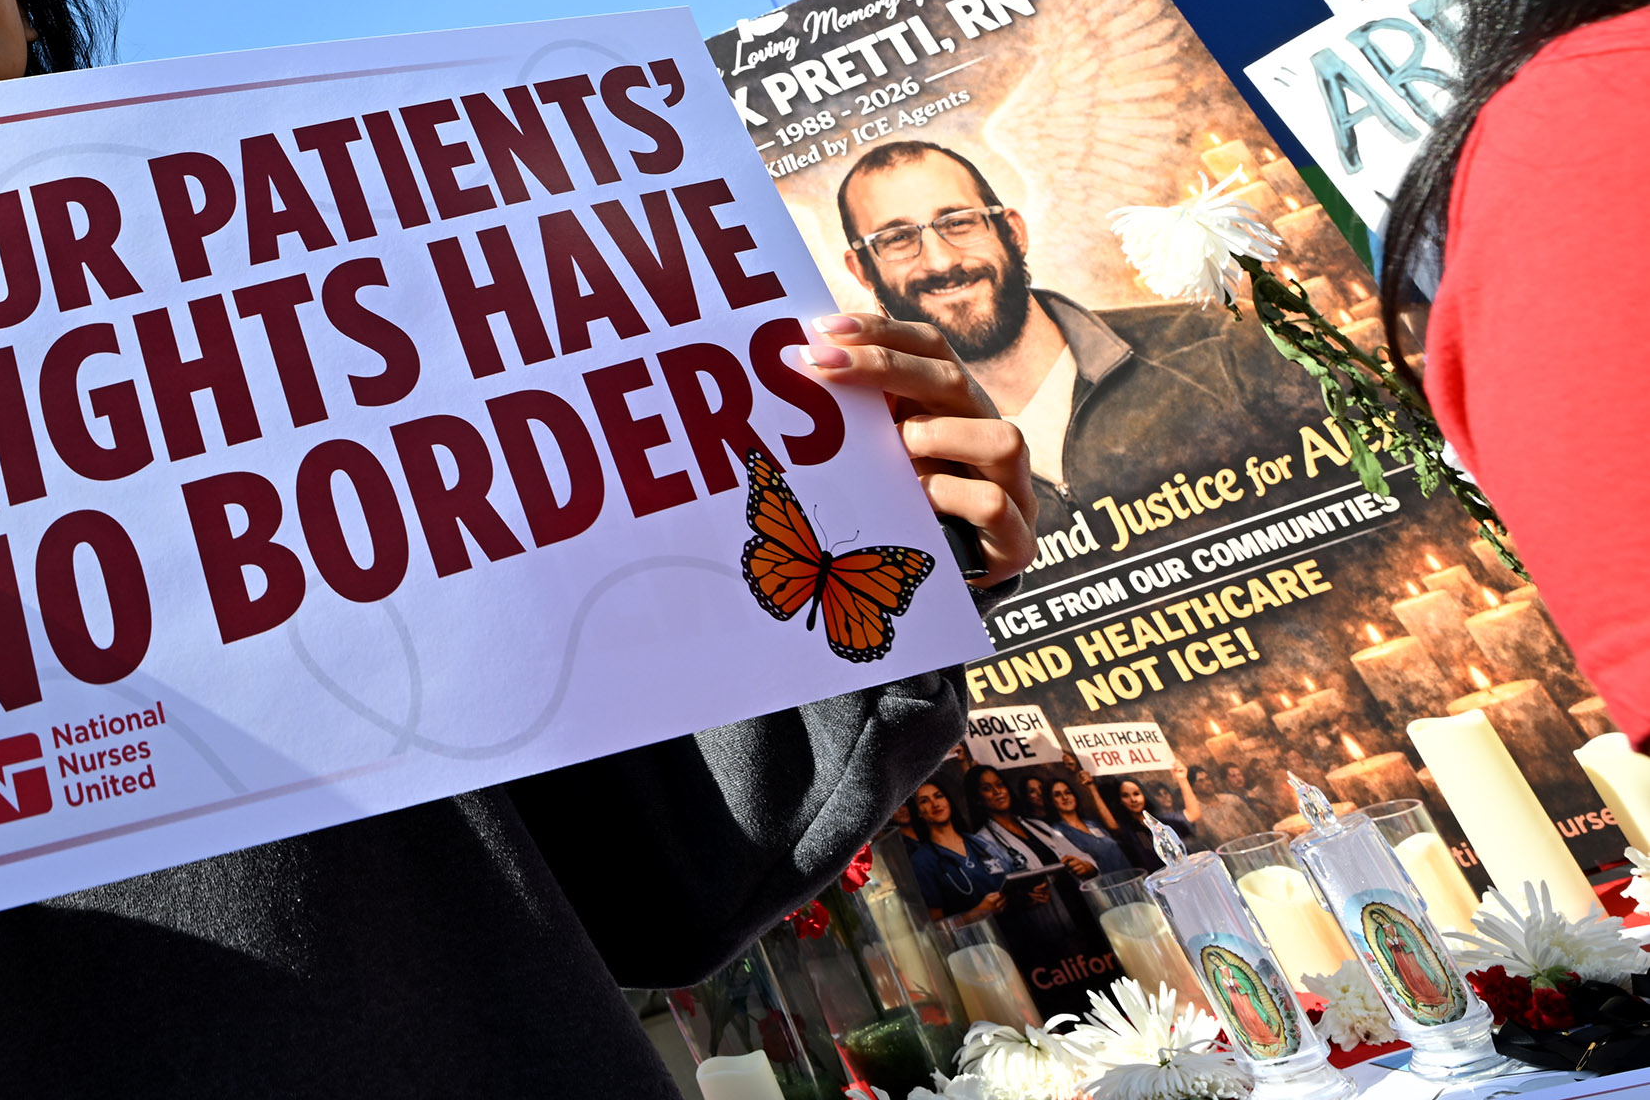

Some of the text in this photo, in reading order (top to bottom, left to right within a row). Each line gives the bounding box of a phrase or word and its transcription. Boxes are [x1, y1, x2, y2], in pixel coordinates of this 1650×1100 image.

[731, 36, 799, 77] Loving
[761, 14, 956, 116] PRETTI,
[764, 87, 971, 180] Killed by ICE Agents
[775, 111, 837, 147] 1988
[855, 76, 921, 114] 2026
[426, 178, 787, 381] HAVE
[181, 315, 848, 647] BORDERS
[1092, 468, 1245, 552] Justice
[1245, 454, 1293, 497] for
[995, 603, 1048, 639] ICE
[1046, 577, 1128, 622] FROM
[1129, 557, 1192, 594] OUR
[1191, 492, 1400, 573] COMMUNITIES
[966, 559, 1333, 704] FUND HEALTHCARE
[1075, 627, 1261, 712] NOT ICE!
[52, 701, 166, 748] National
[968, 712, 1043, 739] ABOLISH
[1072, 729, 1162, 750] HEALTHCARE
[58, 741, 151, 778] Nurses
[990, 736, 1036, 763] ICE
[1091, 747, 1161, 768] FOR ALL
[64, 764, 156, 807] United
[1556, 807, 1618, 839] urse
[1031, 952, 1115, 990] Califor
